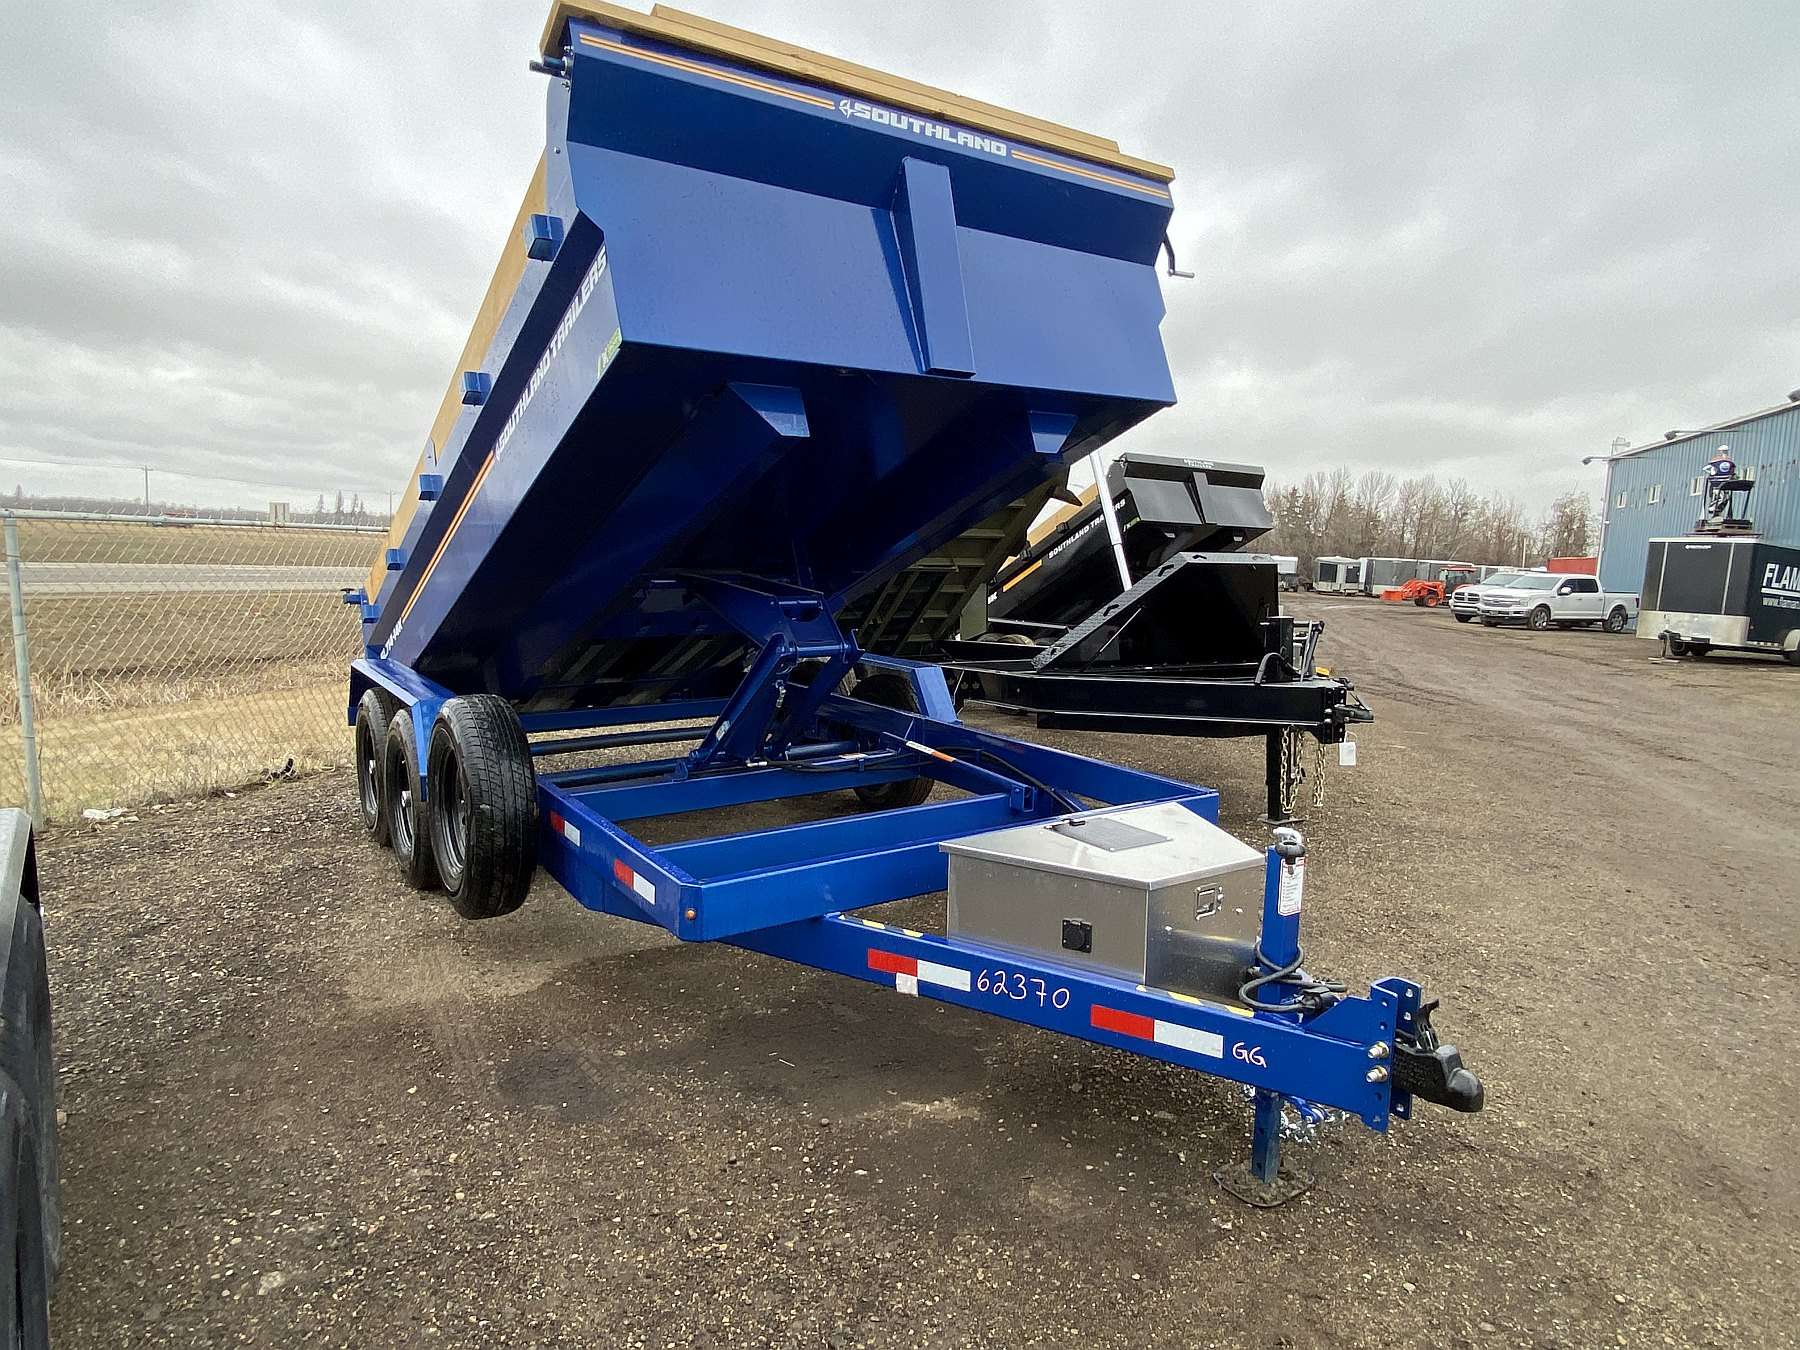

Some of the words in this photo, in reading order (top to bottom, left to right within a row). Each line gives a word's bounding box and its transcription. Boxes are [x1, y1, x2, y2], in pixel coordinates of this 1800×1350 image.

[853, 101, 1007, 157] SOUTHLAND
[499, 348, 551, 452] SOUTHLAND
[549, 244, 608, 358] TRAILERS
[1048, 524, 1090, 559] SOUTHLAND
[977, 969, 1070, 1009] 62370
[1232, 1042, 1267, 1068] GG
